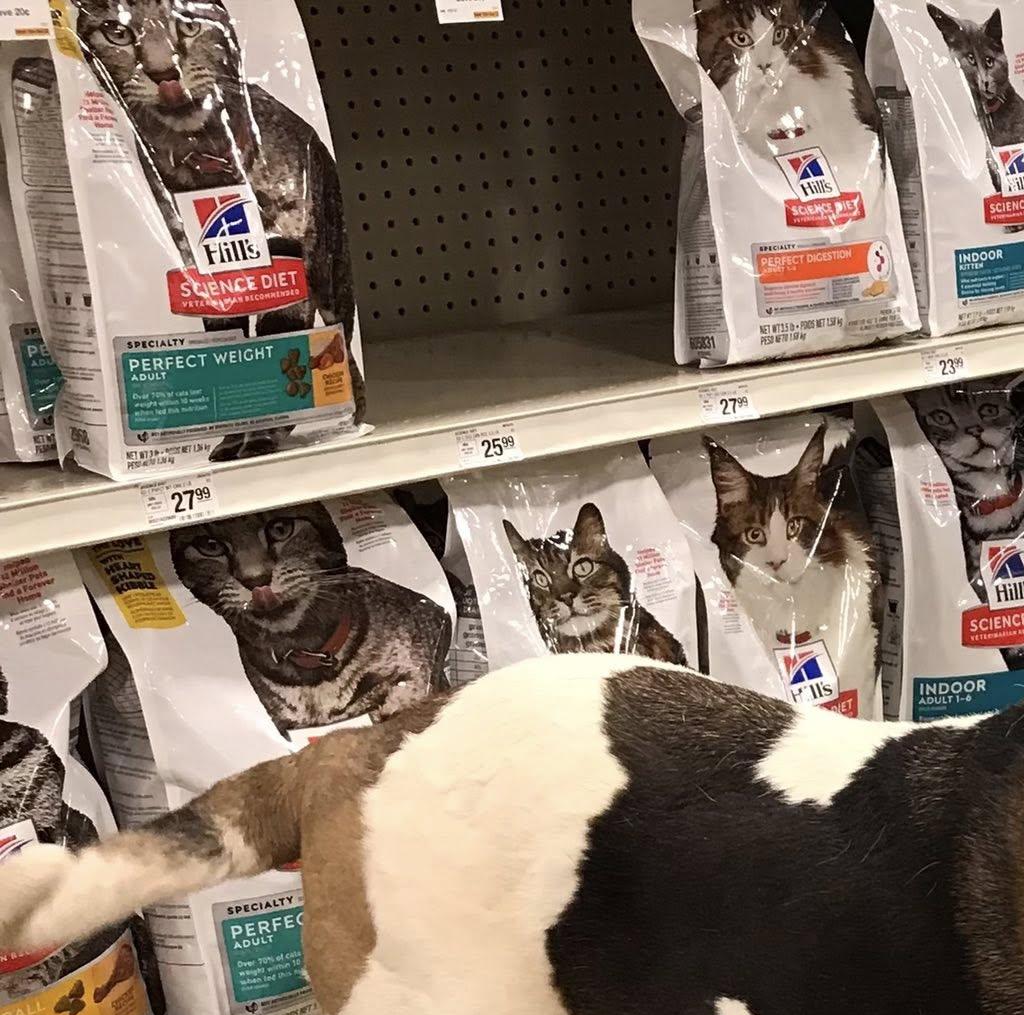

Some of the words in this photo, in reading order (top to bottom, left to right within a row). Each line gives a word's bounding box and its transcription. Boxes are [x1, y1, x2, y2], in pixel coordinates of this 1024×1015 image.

[800, 179, 833, 196] Hill's
[791, 203, 833, 216] SCIENCE
[203, 239, 262, 267] Hill's
[760, 255, 806, 268] PERFECT
[806, 249, 852, 263] DIGESTION
[959, 249, 1003, 263] INDOOR
[959, 262, 984, 271] KITTEN
[180, 276, 258, 298] SCIENCE
[261, 271, 298, 289] DIET
[127, 338, 185, 349] SPECIALTY
[129, 354, 207, 372] PERFECT
[213, 345, 274, 365] WEIGHT
[131, 371, 167, 382] ADULT
[104, 561, 142, 575] HEART
[110, 571, 156, 586] SHAPED
[115, 581, 159, 595] KIBBLE
[919, 679, 986, 695] INDOOR
[918, 695, 952, 705] ADULT
[227, 896, 294, 915] SPECIALTY
[230, 912, 304, 939] PERFEC
[233, 935, 274, 949] ADULT
[237, 959, 256, 968] Over
